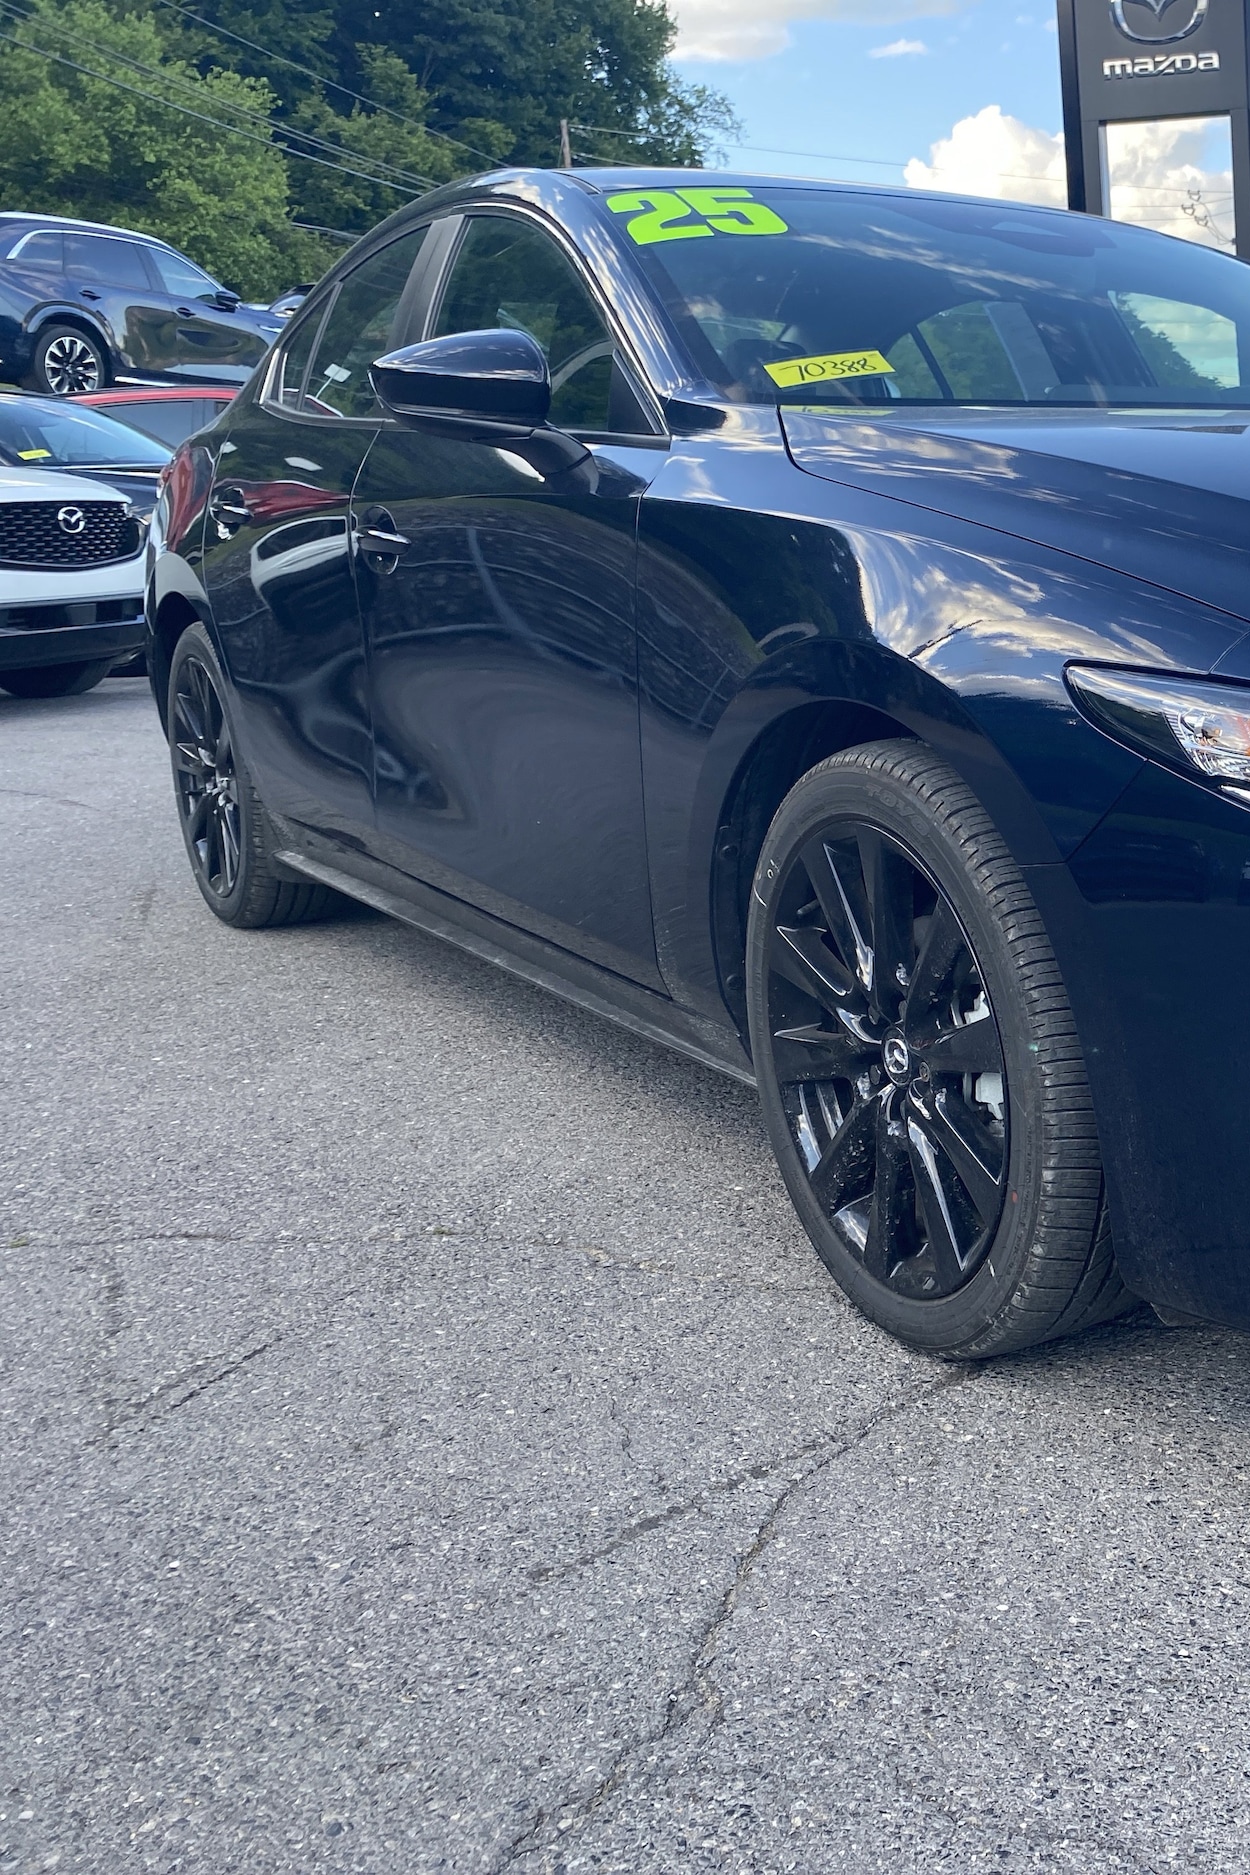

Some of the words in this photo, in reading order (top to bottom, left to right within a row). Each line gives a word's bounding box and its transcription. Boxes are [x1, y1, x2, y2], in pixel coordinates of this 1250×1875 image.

[1102, 50, 1221, 80] mazda
[606, 188, 789, 246] 25
[778, 357, 878, 382] 70388
